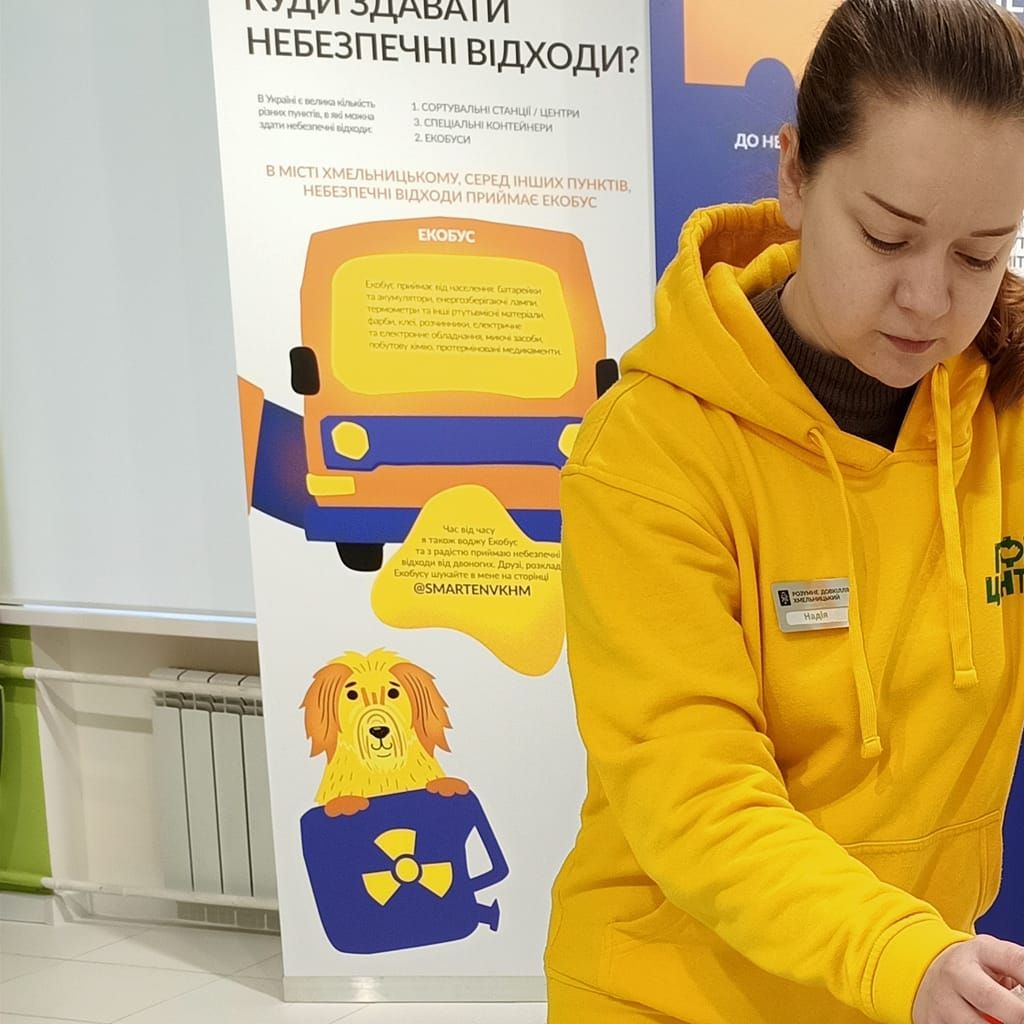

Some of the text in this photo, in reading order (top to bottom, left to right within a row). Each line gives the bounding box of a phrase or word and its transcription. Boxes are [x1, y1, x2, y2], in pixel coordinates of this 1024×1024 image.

[247, 27, 639, 78] НЕБЕЗПЕЧНІ ВІДХОДИ?
[257, 94, 264, 103] В
[265, 95, 296, 105] Україні
[305, 98, 335, 106] велика
[337, 98, 376, 108] кількість
[259, 107, 286, 117] різних
[422, 103, 490, 114] СОРТУВАЛЬНІ
[492, 105, 530, 117] СТАНЦІЇ
[540, 108, 580, 118] ЦЕНТРИ
[260, 121, 285, 130] здати
[287, 121, 335, 131] небезпечні
[424, 119, 484, 129] СПЕЦІАЛЬНІ
[487, 120, 553, 132] КОНТЕЙНЕРИ
[425, 134, 471, 144] ЕКОБУСИ
[734, 133, 759, 150] ДО
[266, 165, 631, 193] В МІСТІ ХМЕЛЬНИЦЬКОМУ, СЕРЕД ІНШИХ ПУНКТІВ,
[304, 185, 597, 208] НЕБЕЗПЕЧНІ ВІДХОДИ ПРИЙМАЄ ЕКОБУС
[418, 228, 475, 243] ЕКОБУС
[443, 525, 459, 533] Час
[461, 526, 474, 534] від
[434, 548, 468, 556] радістю
[471, 549, 511, 557] приймаю
[513, 550, 560, 558] небезпечні
[394, 569, 429, 579] Екобусу
[431, 571, 468, 579] шукайте
[514, 573, 549, 582] сторінці
[414, 583, 531, 596] @SMARTENVKHM
[804, 611, 828, 621] Надія
